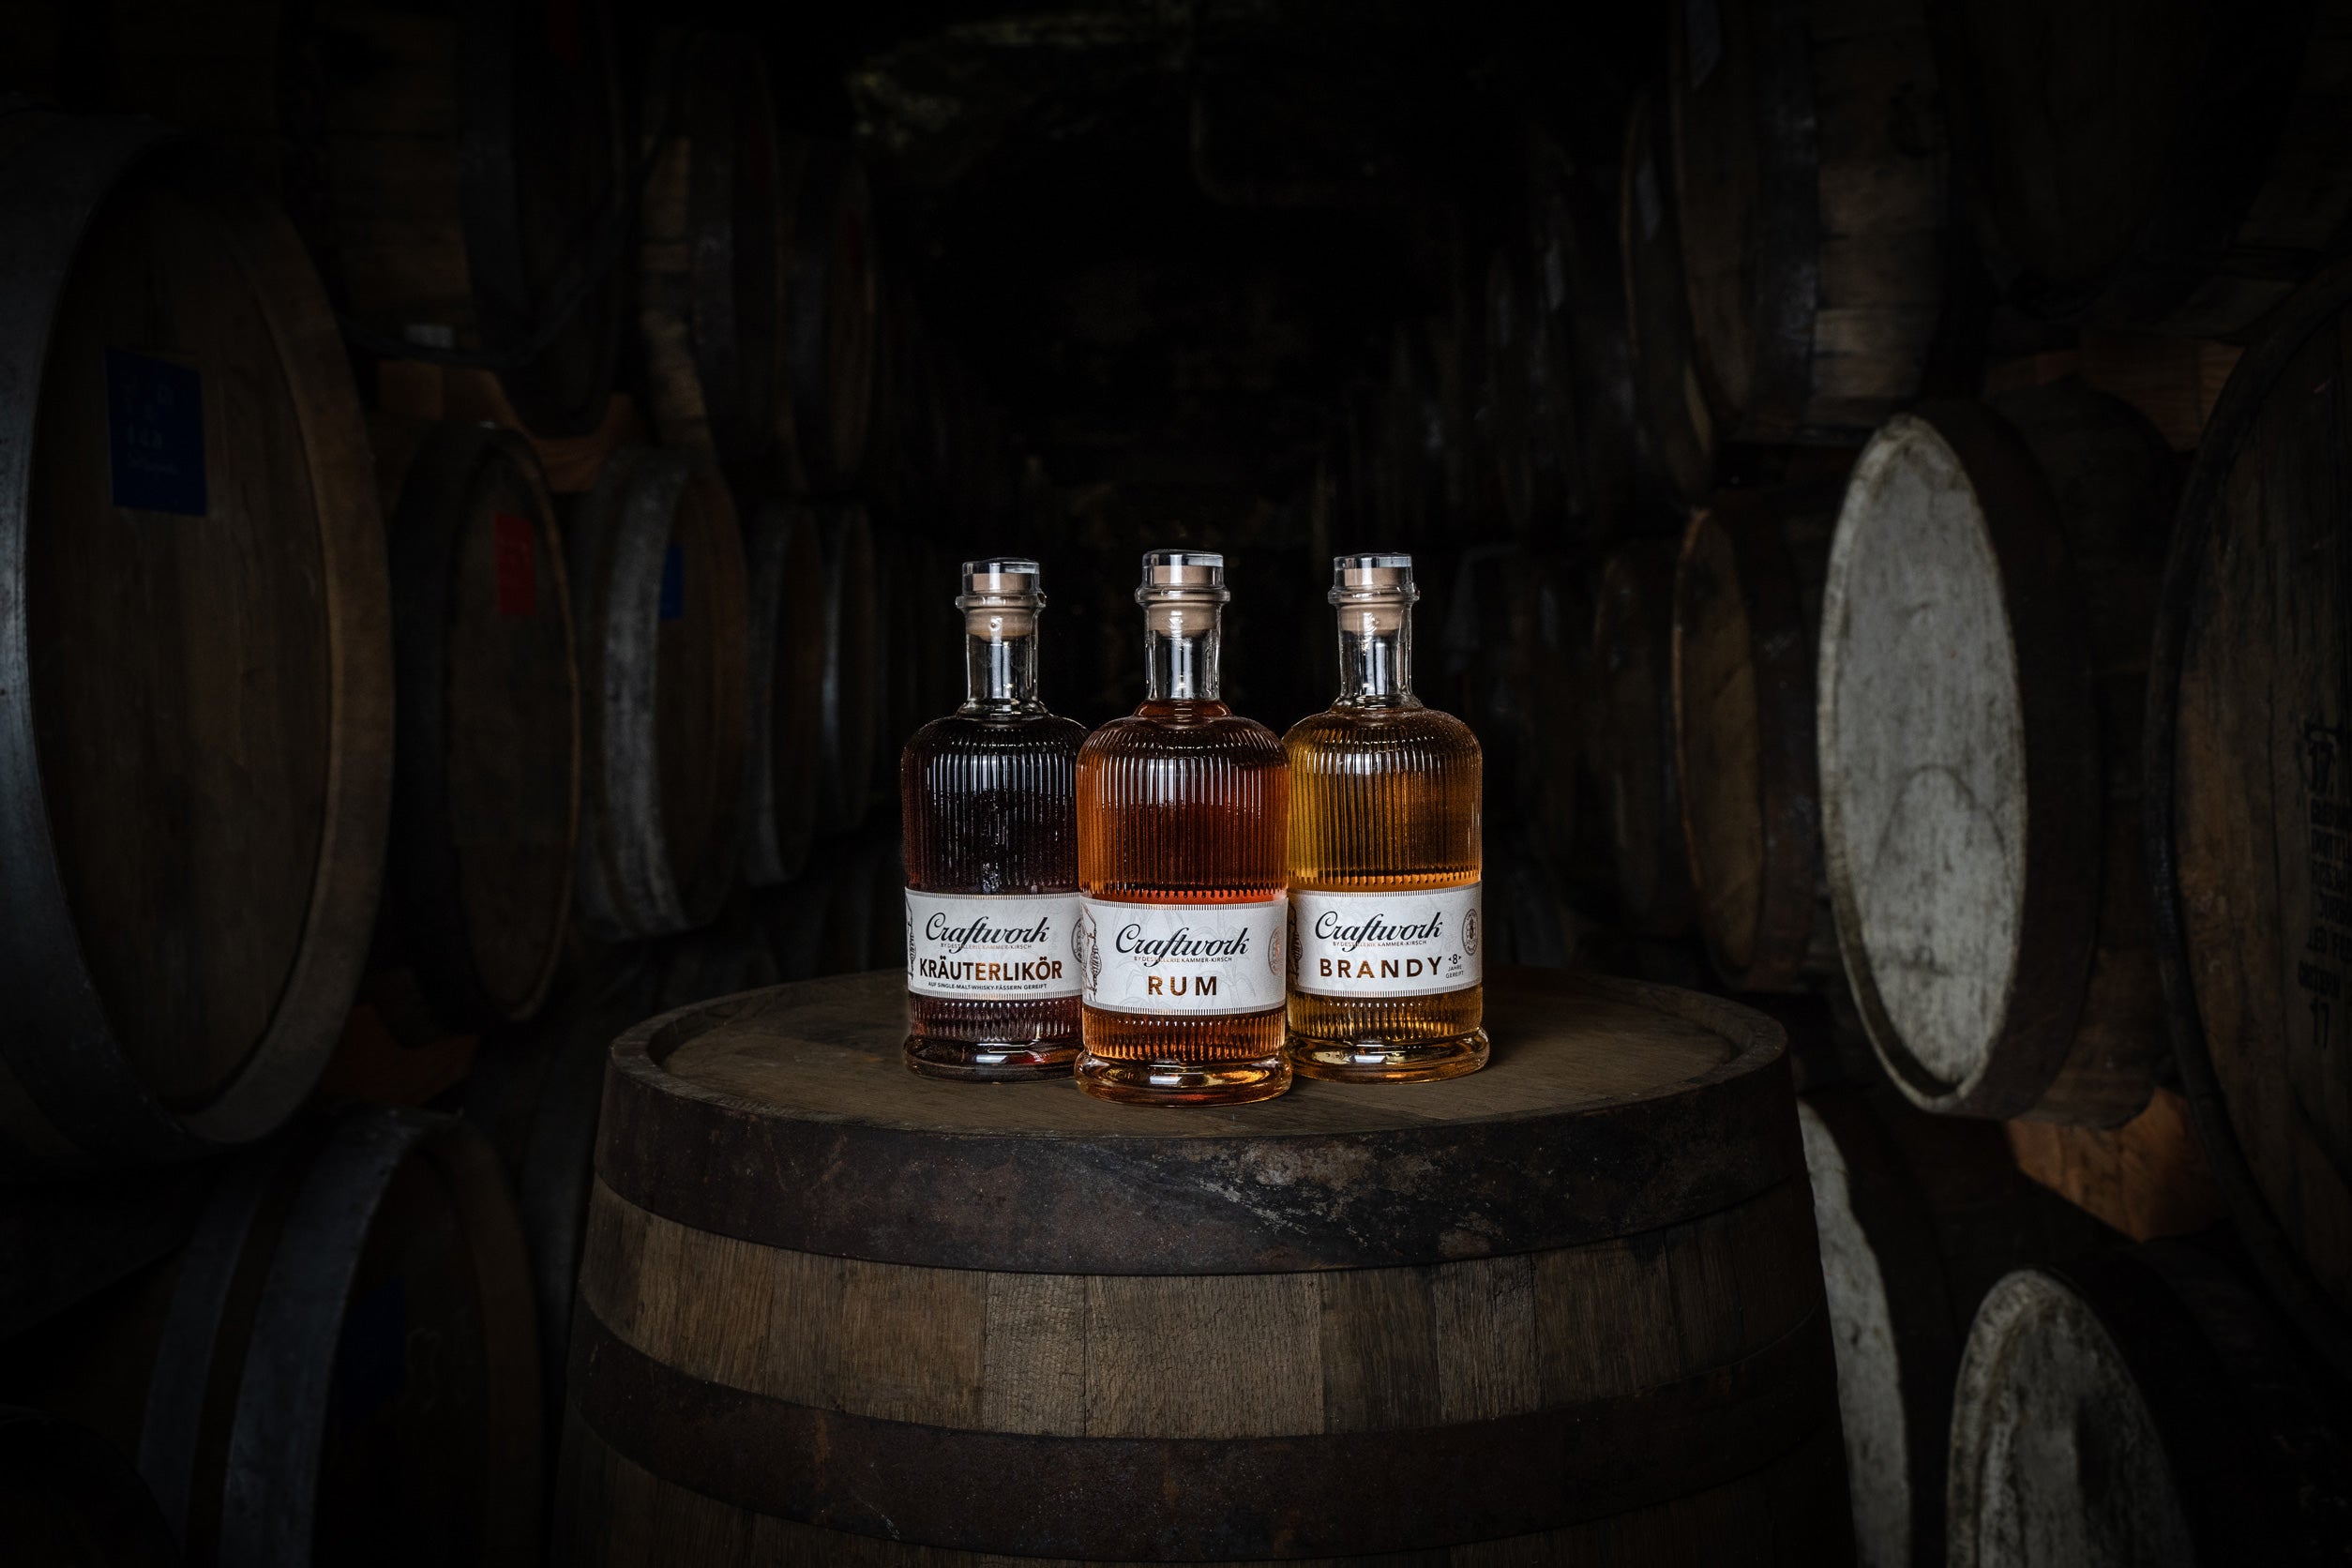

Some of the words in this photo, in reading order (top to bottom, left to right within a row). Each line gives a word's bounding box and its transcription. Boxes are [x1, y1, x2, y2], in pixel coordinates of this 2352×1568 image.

[926, 912, 1050, 954] Craftwork
[1115, 923, 1250, 968] Craftwork
[1315, 911, 1442, 953] Craftwork
[920, 955, 1063, 982] KRÄUTERLIKÖR
[1319, 956, 1441, 978] BRANDY
[1452, 953, 1458, 965] 8
[1148, 975, 1217, 997] RUM
